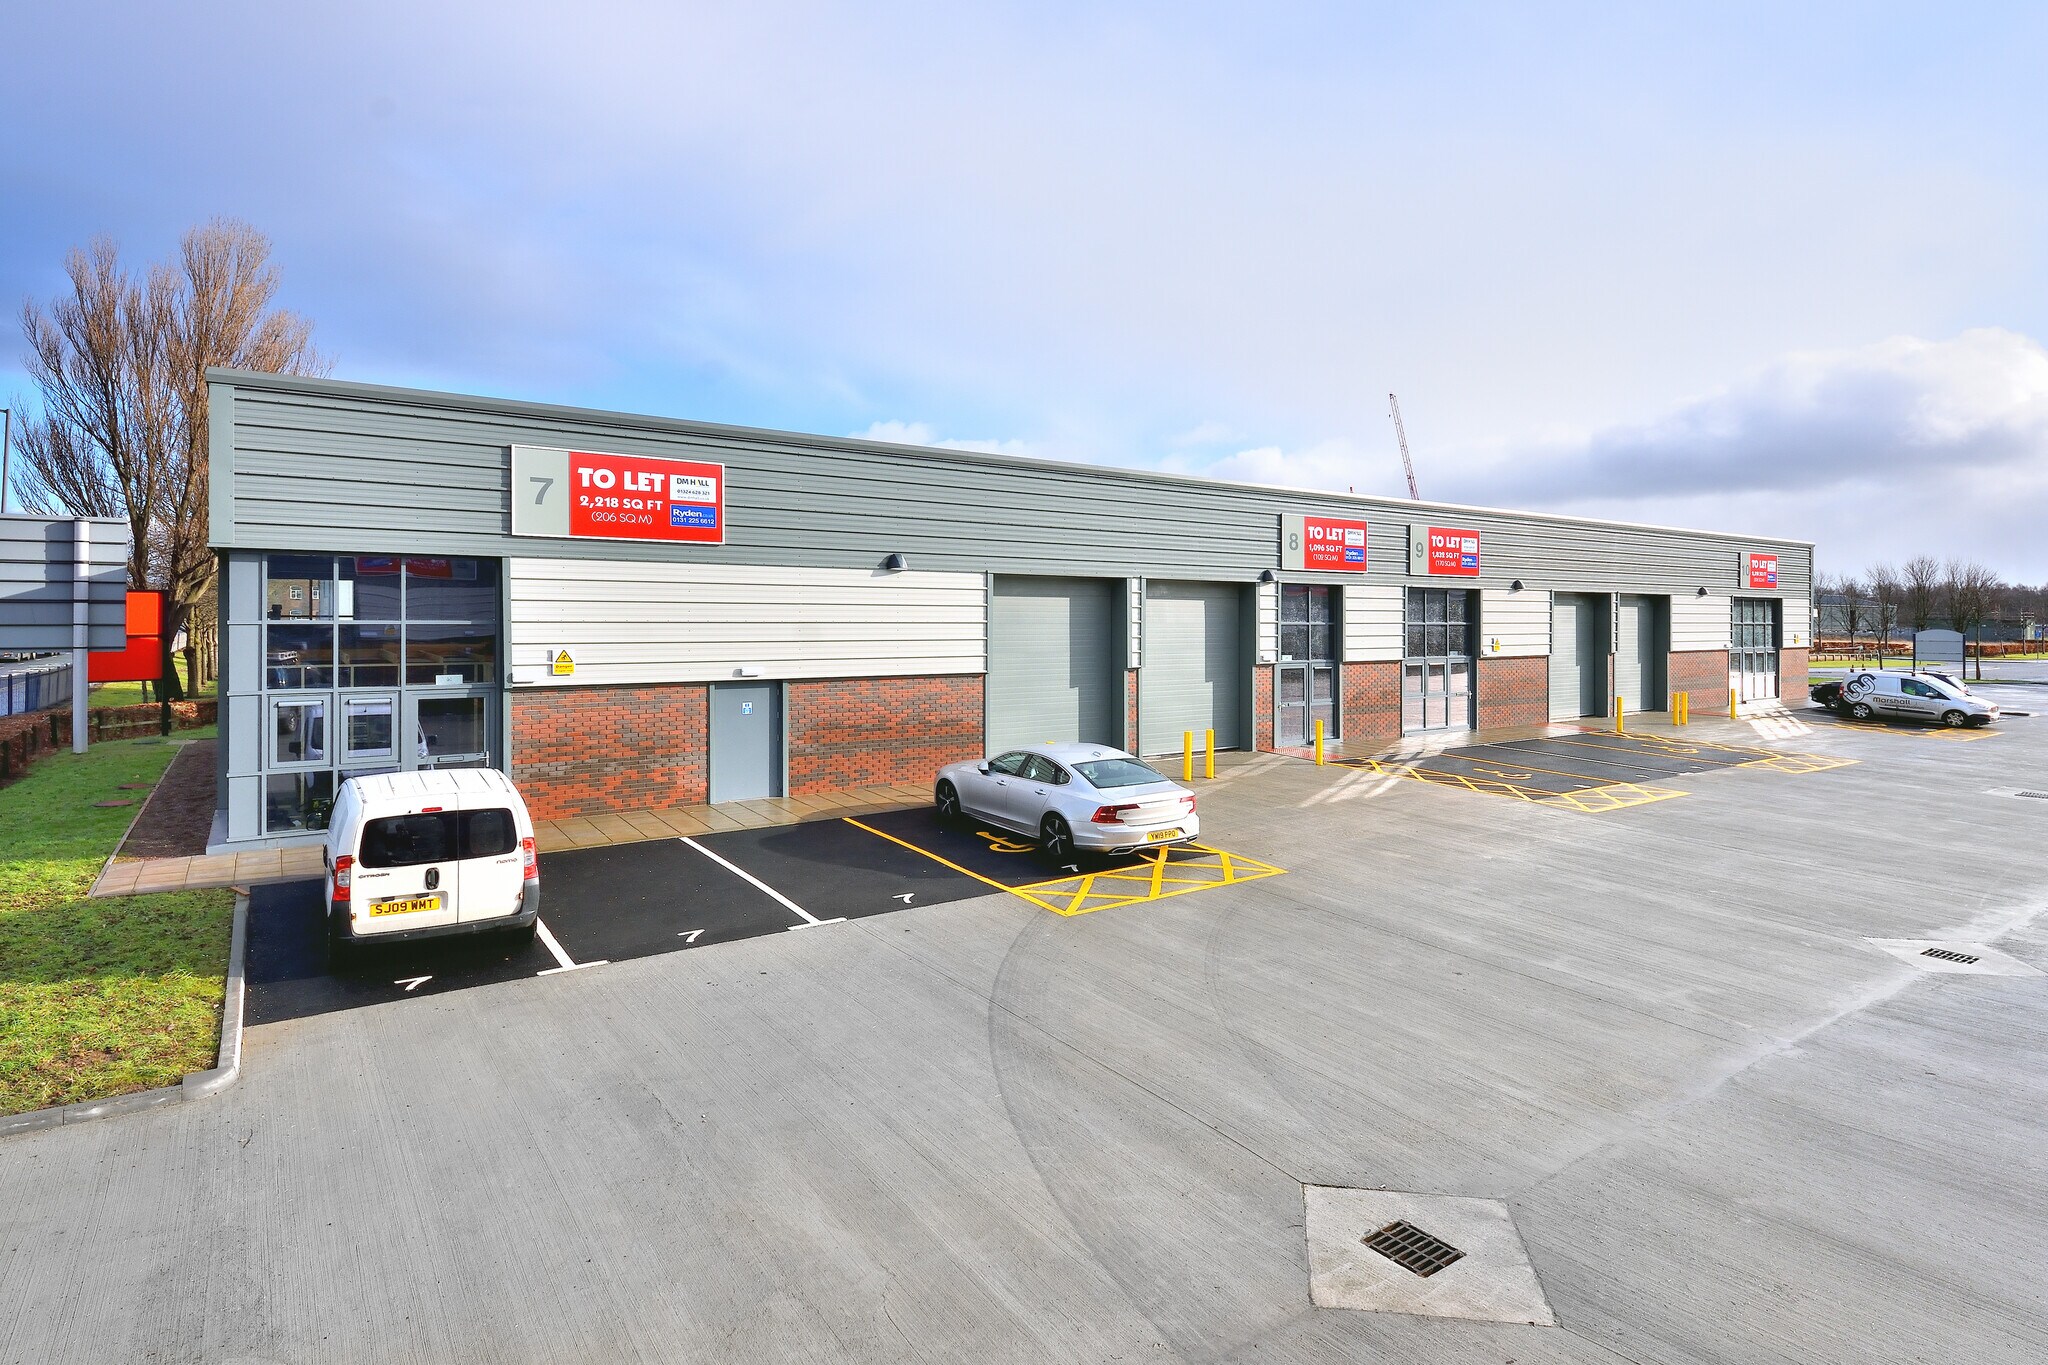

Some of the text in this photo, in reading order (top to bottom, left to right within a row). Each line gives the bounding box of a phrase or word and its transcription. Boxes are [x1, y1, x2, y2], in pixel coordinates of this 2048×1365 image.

[577, 467, 665, 492] TO LET
[676, 477, 689, 485] DM
[530, 476, 554, 505] 7
[580, 495, 663, 510] 2,218 SQ FT
[591, 511, 653, 525] (206 SQ M)
[1308, 526, 1324, 540] TO
[1326, 527, 1344, 541] LET
[1289, 533, 1299, 551] 8
[1415, 541, 1424, 558] 9
[1431, 535, 1444, 548] TO
[1446, 536, 1460, 549] LET
[1751, 560, 1759, 569] TO
[1759, 560, 1767, 569] LET
[1872, 696, 1911, 705] marshall
[375, 899, 435, 915] SJ09 WMT
